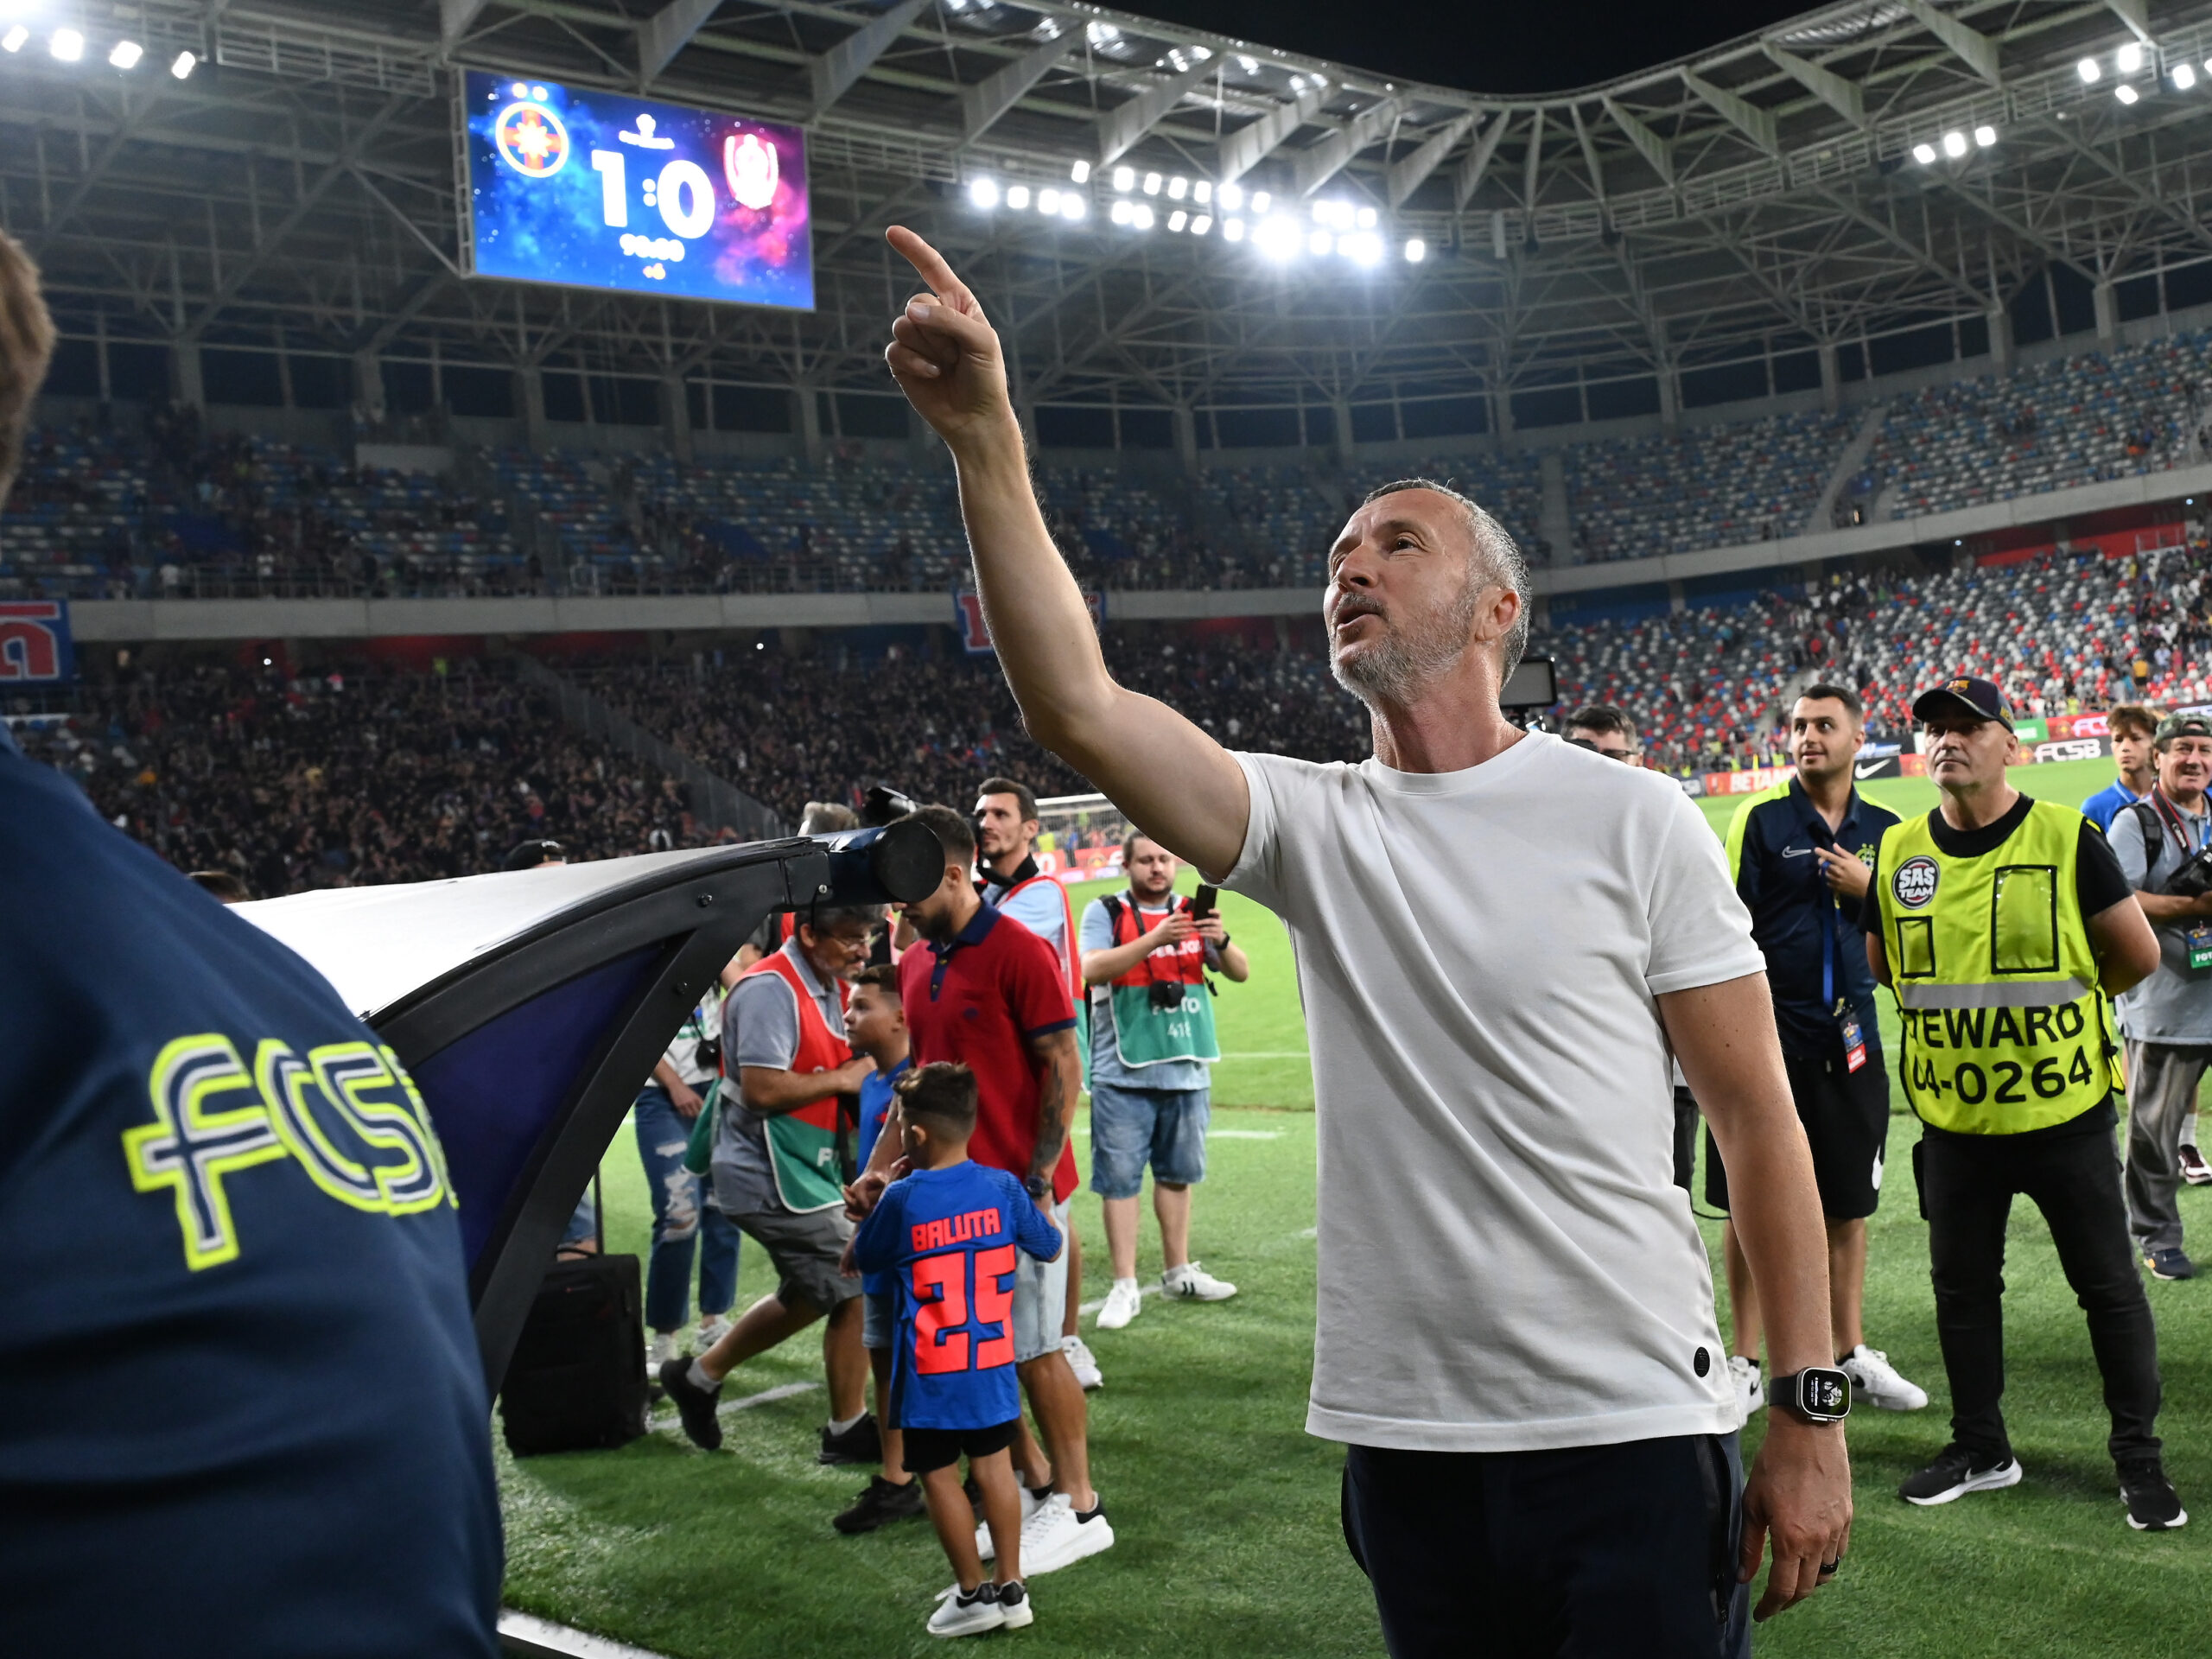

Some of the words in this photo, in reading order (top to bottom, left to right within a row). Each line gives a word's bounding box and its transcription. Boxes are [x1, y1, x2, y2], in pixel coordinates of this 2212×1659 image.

[2035, 739, 2101, 764] FCSB
[1898, 867, 1936, 889] SAS
[1898, 887, 1934, 899] TEAM
[1902, 1001, 2084, 1049] TEWARD
[121, 1033, 460, 1272] FCS
[912, 1207, 1001, 1252] BALUTA
[912, 1243, 1016, 1375] 25
